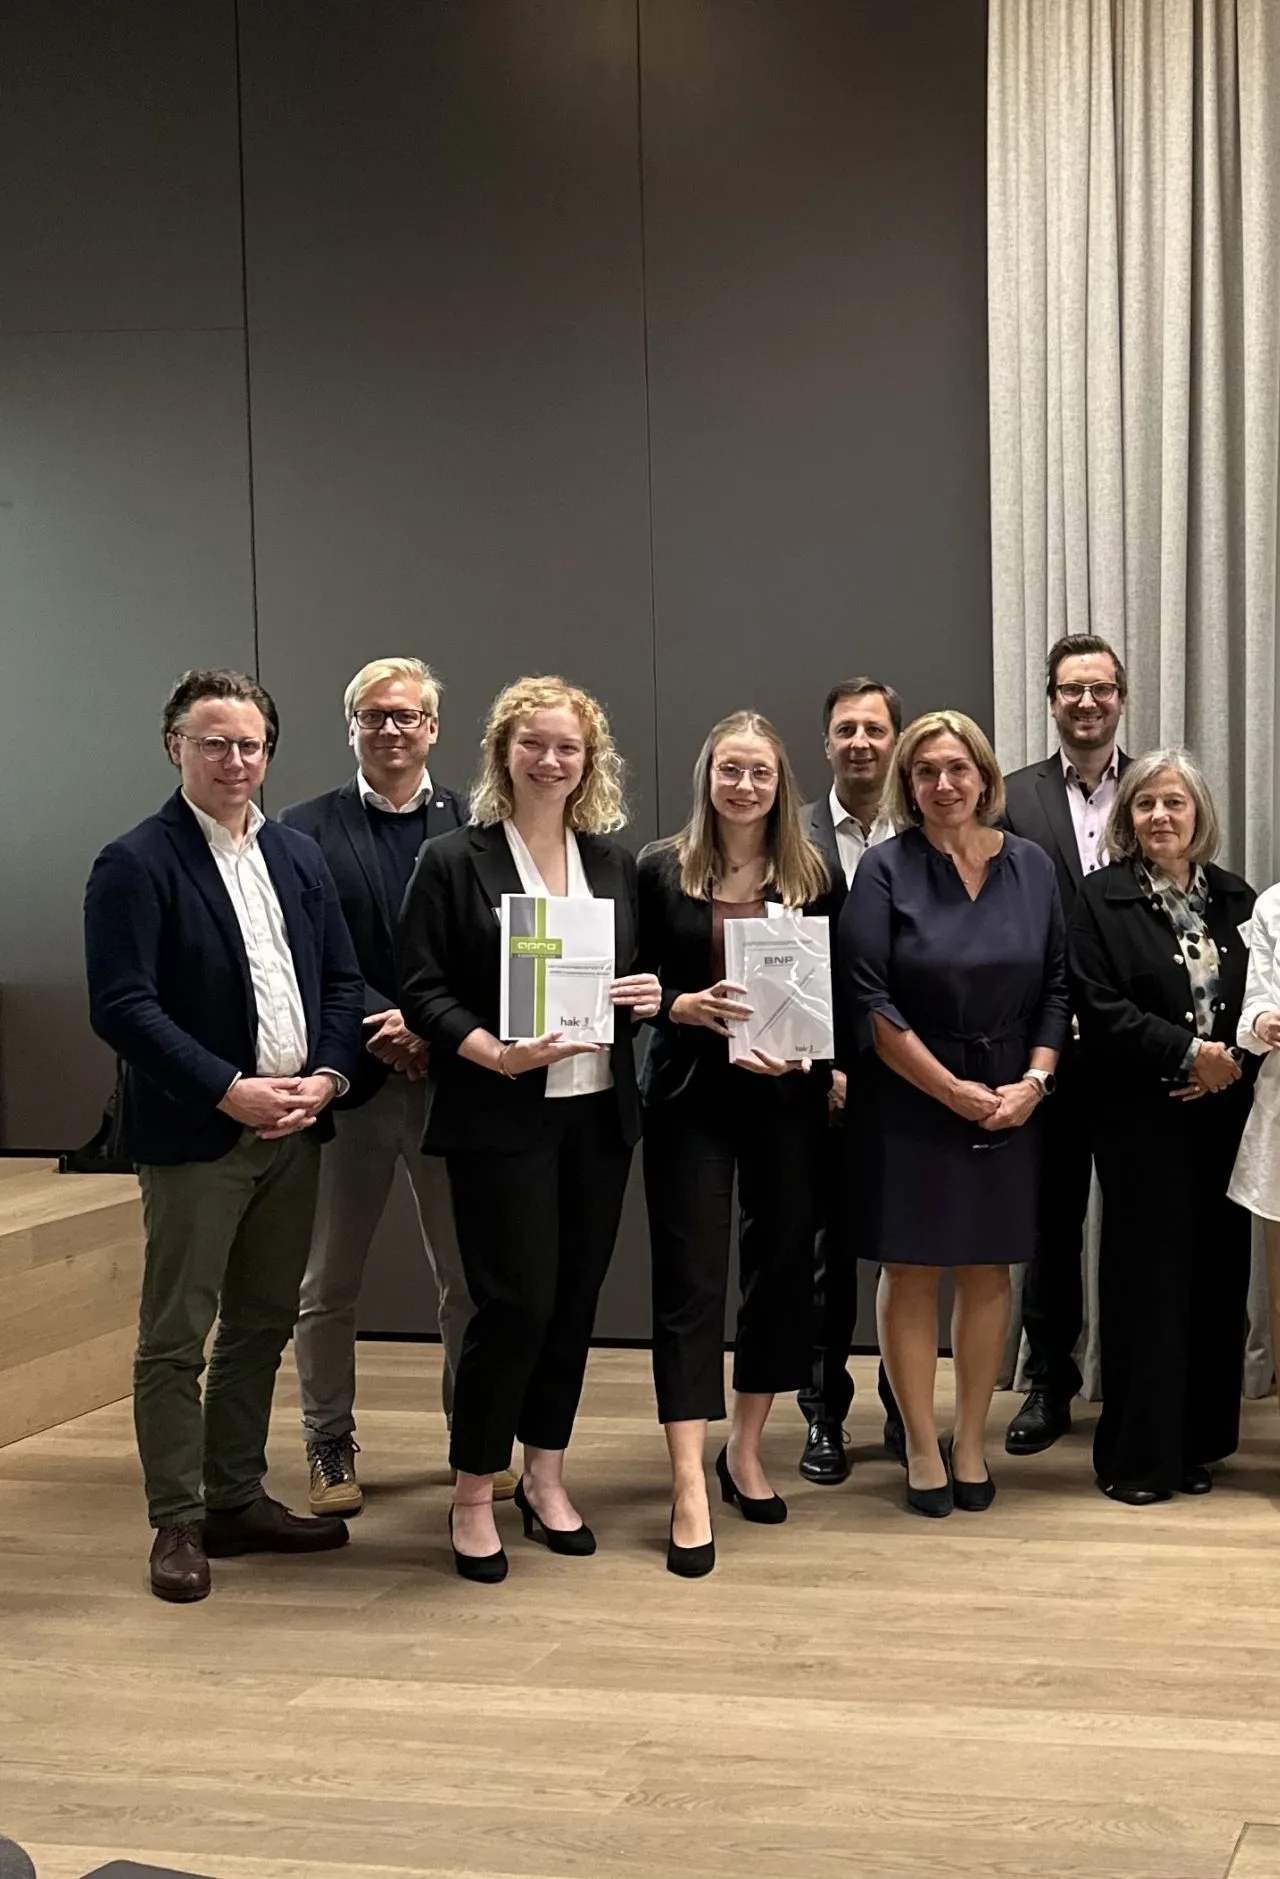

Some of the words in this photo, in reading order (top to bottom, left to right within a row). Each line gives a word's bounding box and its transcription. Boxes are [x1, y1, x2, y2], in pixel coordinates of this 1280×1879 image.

[517, 941, 557, 951] apro
[764, 956, 794, 965] BNP
[560, 1016, 580, 1027] hak
